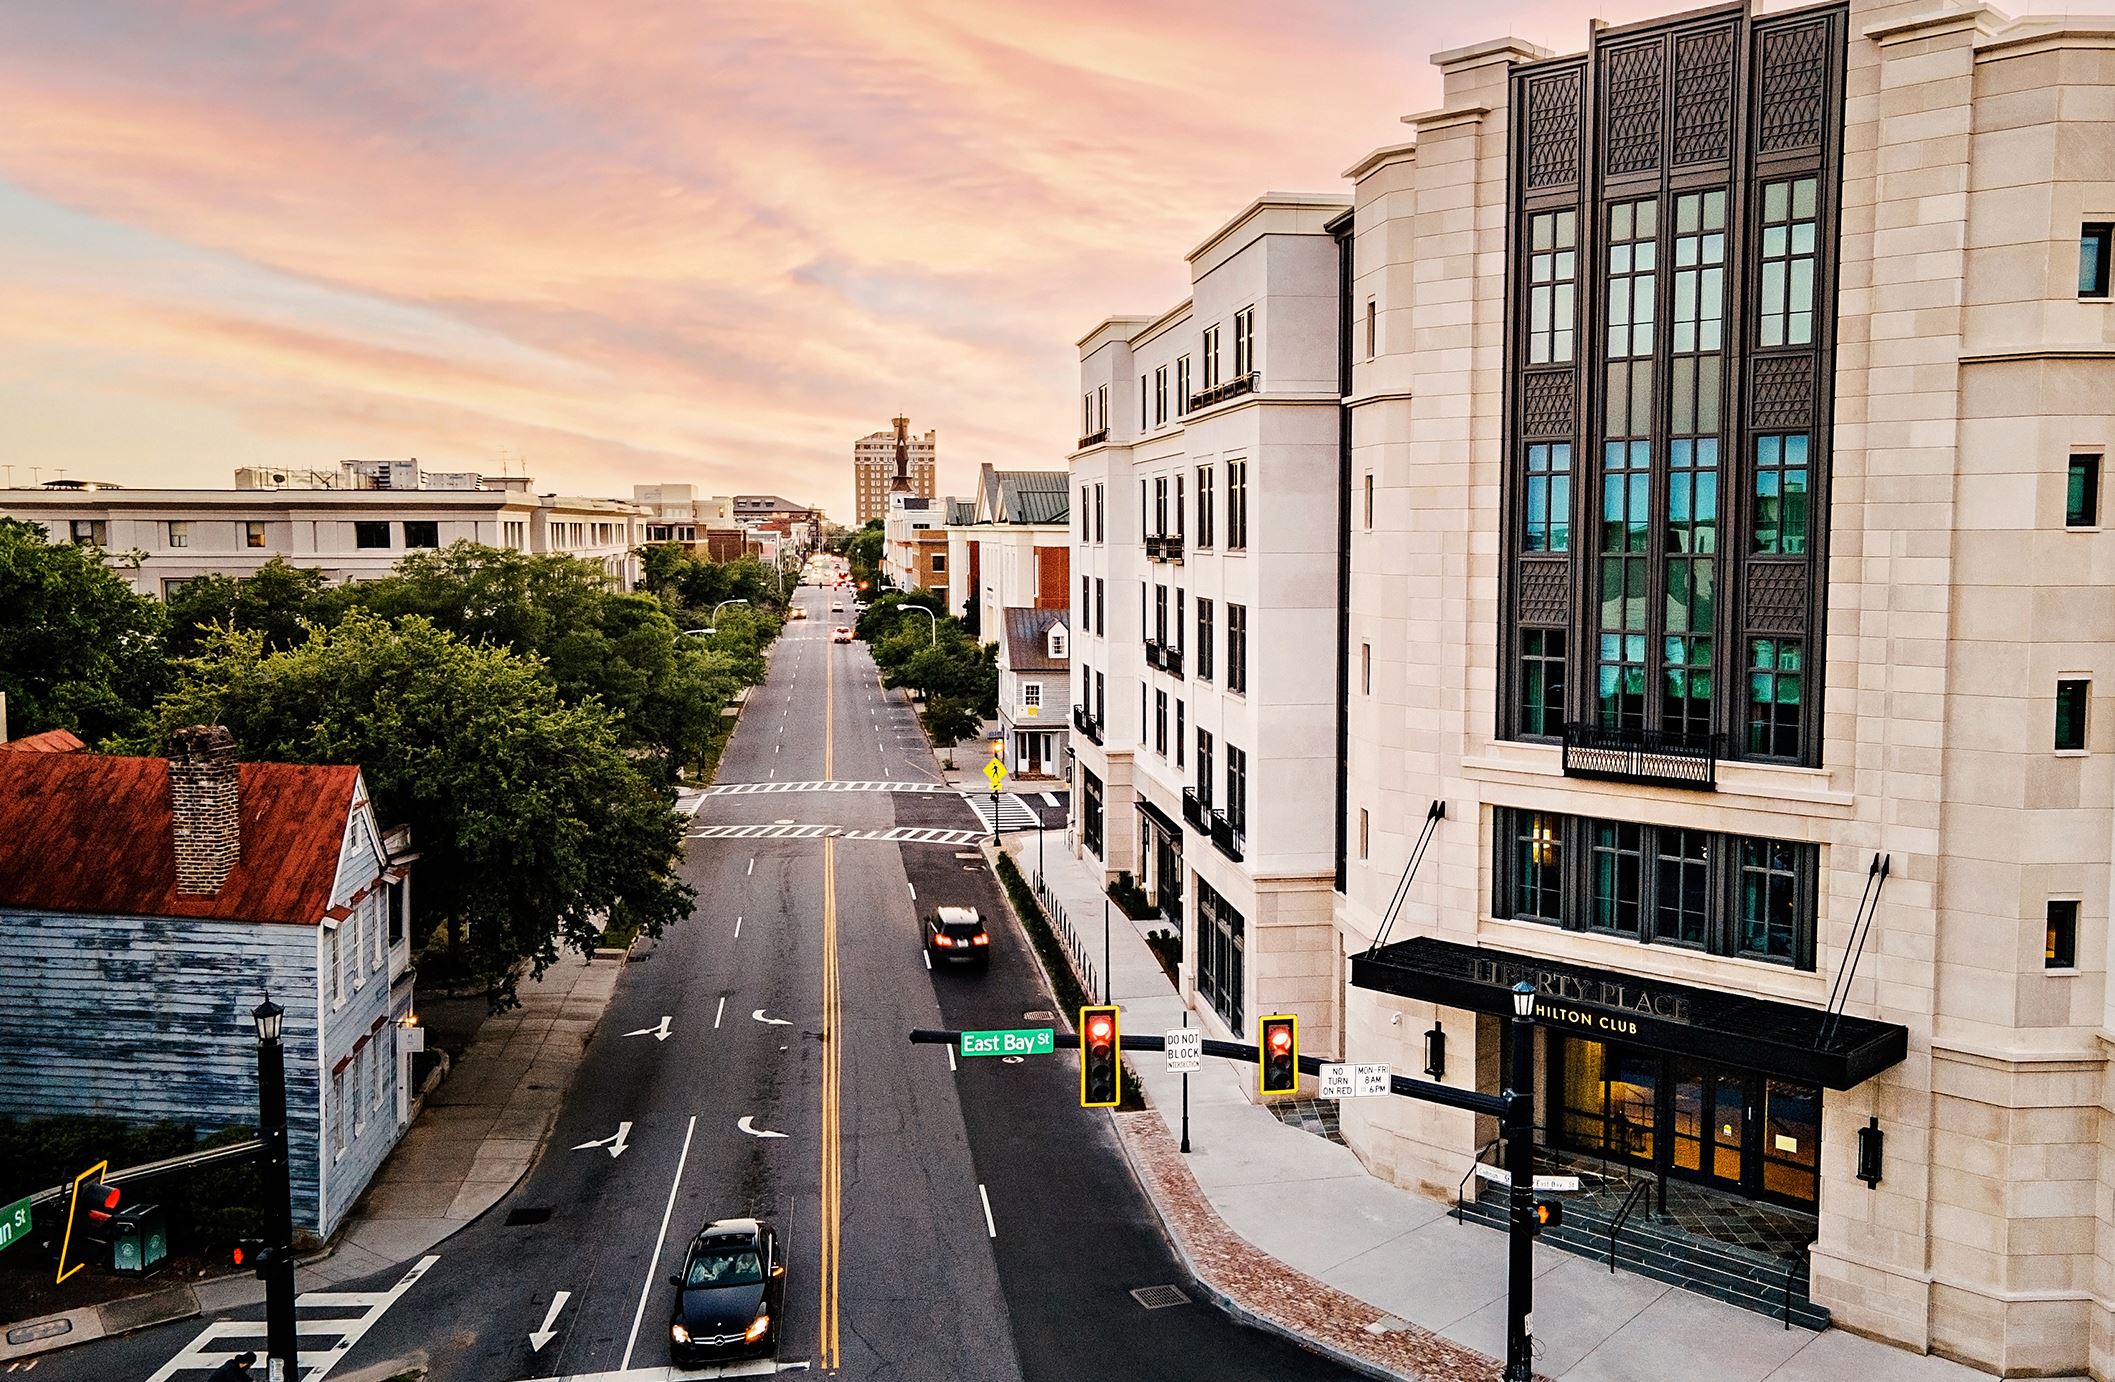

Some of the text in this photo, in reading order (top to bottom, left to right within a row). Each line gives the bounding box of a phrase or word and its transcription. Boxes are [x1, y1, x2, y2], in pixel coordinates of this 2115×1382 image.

[1600, 981, 1690, 1021] PLACE
[1535, 1004, 1637, 1034] HILTON CLUB
[964, 1032, 1050, 1054] East Bay St
[1168, 1034, 1198, 1045] DO NOT
[1168, 1048, 1199, 1059] BLOCK
[1333, 1067, 1343, 1075] NO
[1358, 1066, 1388, 1074] MON-FRI
[1328, 1077, 1348, 1085] TURN
[1323, 1086, 1334, 1095] ON
[1336, 1086, 1353, 1095] RED
[15, 1208, 26, 1227] St
